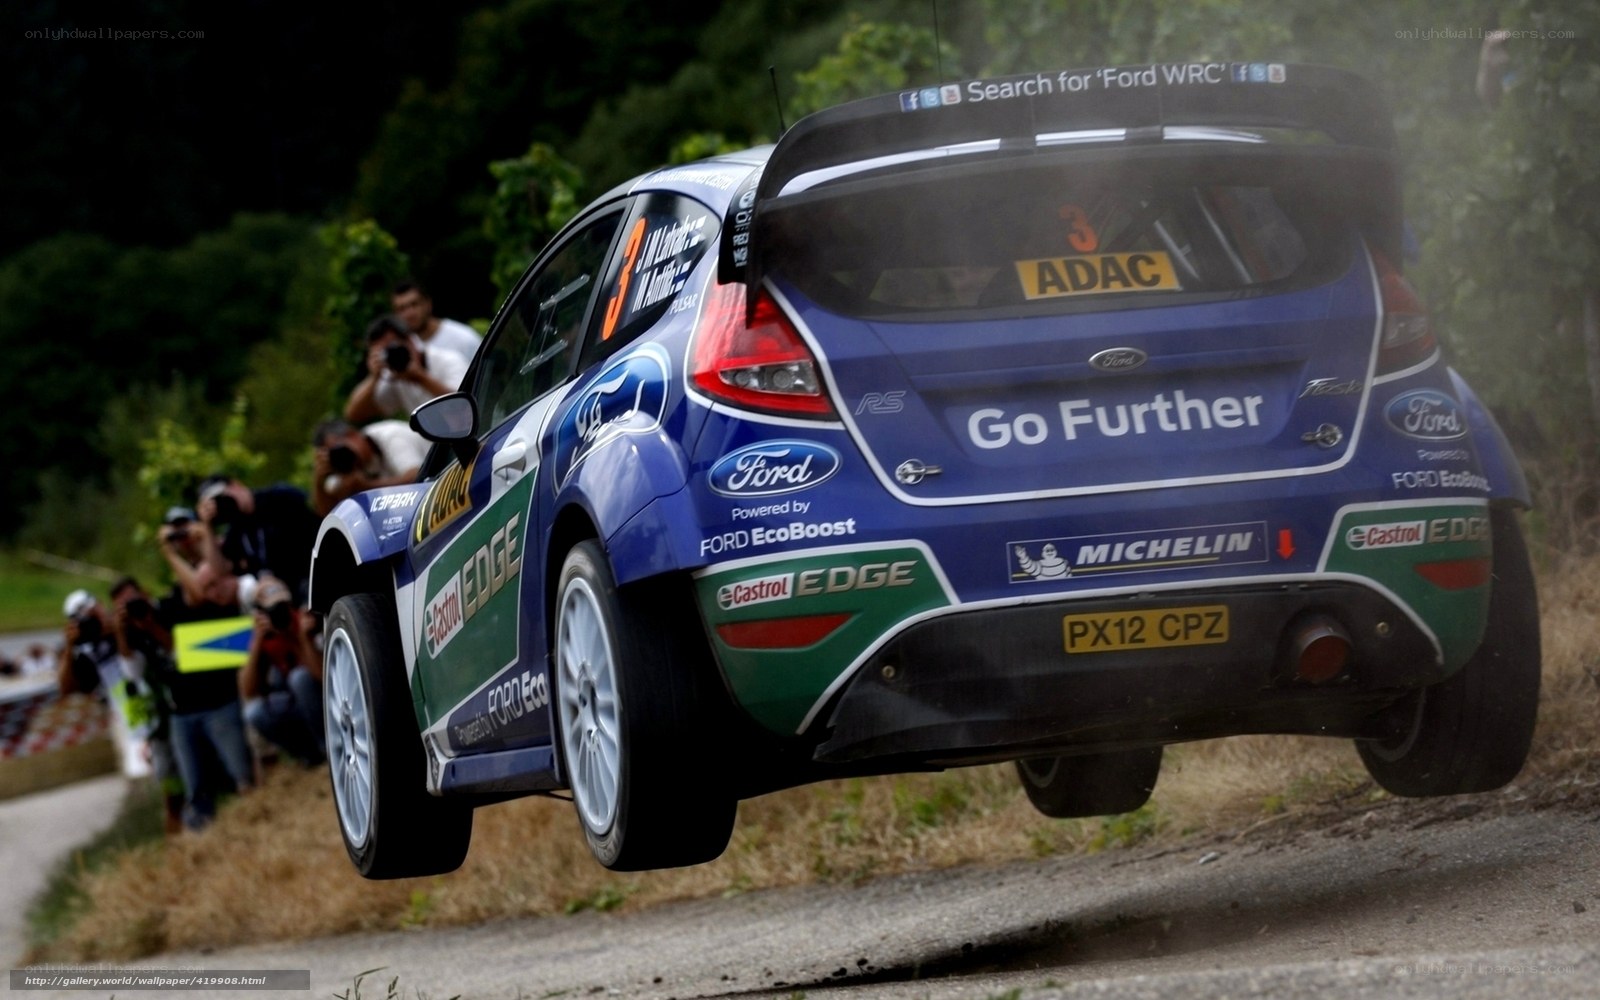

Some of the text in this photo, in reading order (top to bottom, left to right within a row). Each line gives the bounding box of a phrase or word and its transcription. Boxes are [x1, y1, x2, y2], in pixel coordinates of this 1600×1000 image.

[967, 73, 1053, 103] Search
[1057, 71, 1091, 92] for
[1059, 204, 1099, 252] 3
[602, 216, 647, 341] 3
[1037, 253, 1162, 295] ADAC
[1102, 352, 1136, 367] Ford
[855, 391, 907, 416] RS
[967, 389, 1264, 450] Go Further
[1404, 396, 1462, 432] Ford
[727, 448, 814, 491] Ford
[1391, 470, 1439, 489] FORD
[732, 500, 811, 521] Powered by
[700, 518, 857, 558] FORD EcoBoost
[1076, 532, 1254, 565] MICHELIN
[1366, 524, 1421, 547] Castrol
[433, 511, 522, 648] Castrol EDGE
[732, 560, 919, 606] Castrol EDGE
[1068, 612, 1225, 648] PX12 CPZ
[488, 677, 523, 730] FORD
